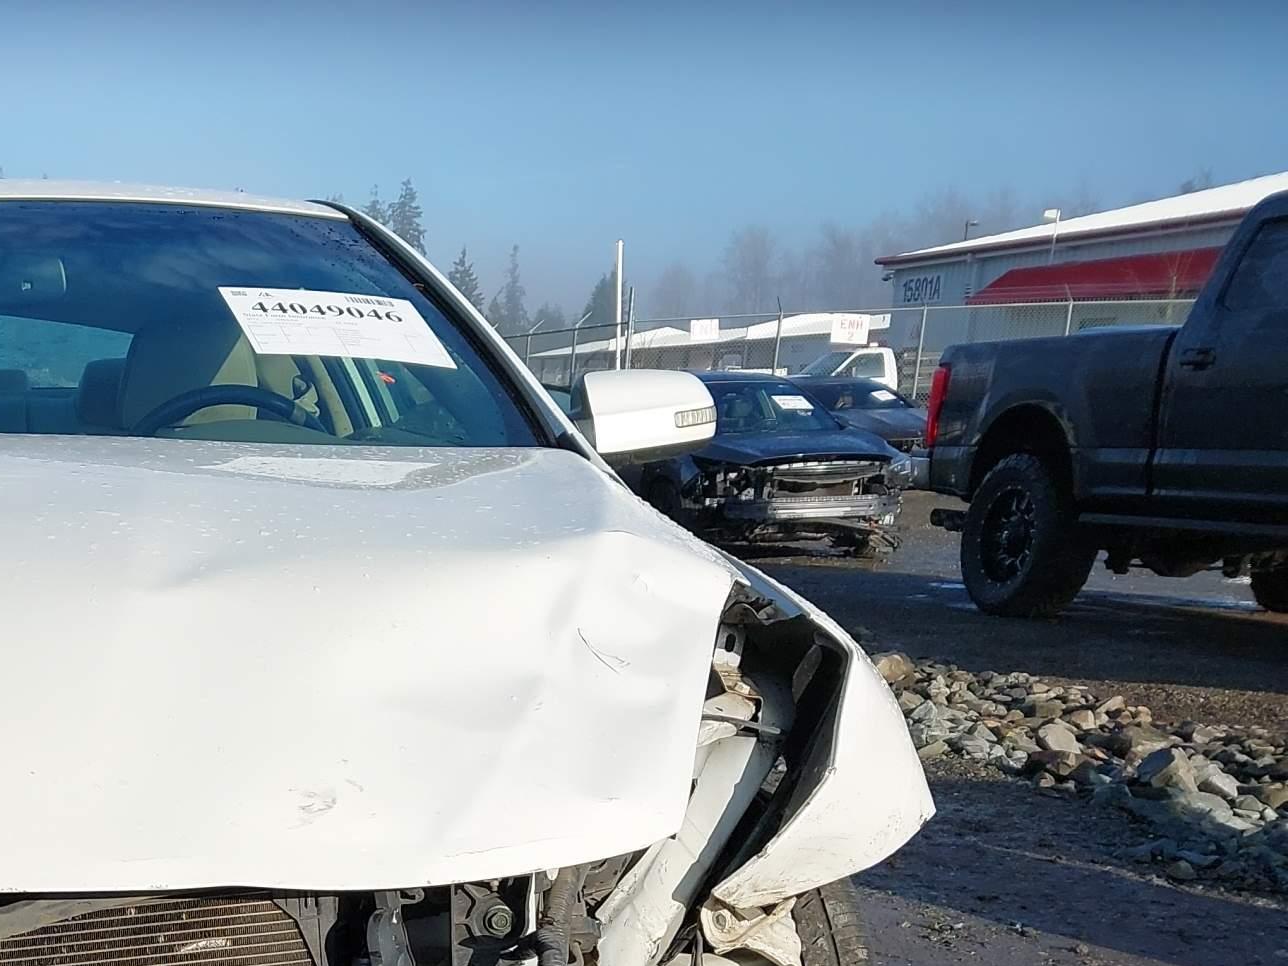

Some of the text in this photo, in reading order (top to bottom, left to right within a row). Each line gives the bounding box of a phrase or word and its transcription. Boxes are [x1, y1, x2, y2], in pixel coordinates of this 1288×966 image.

[903, 275, 941, 303] 15801A
[251, 301, 404, 323] 44049046
[840, 319, 863, 330] ENH
